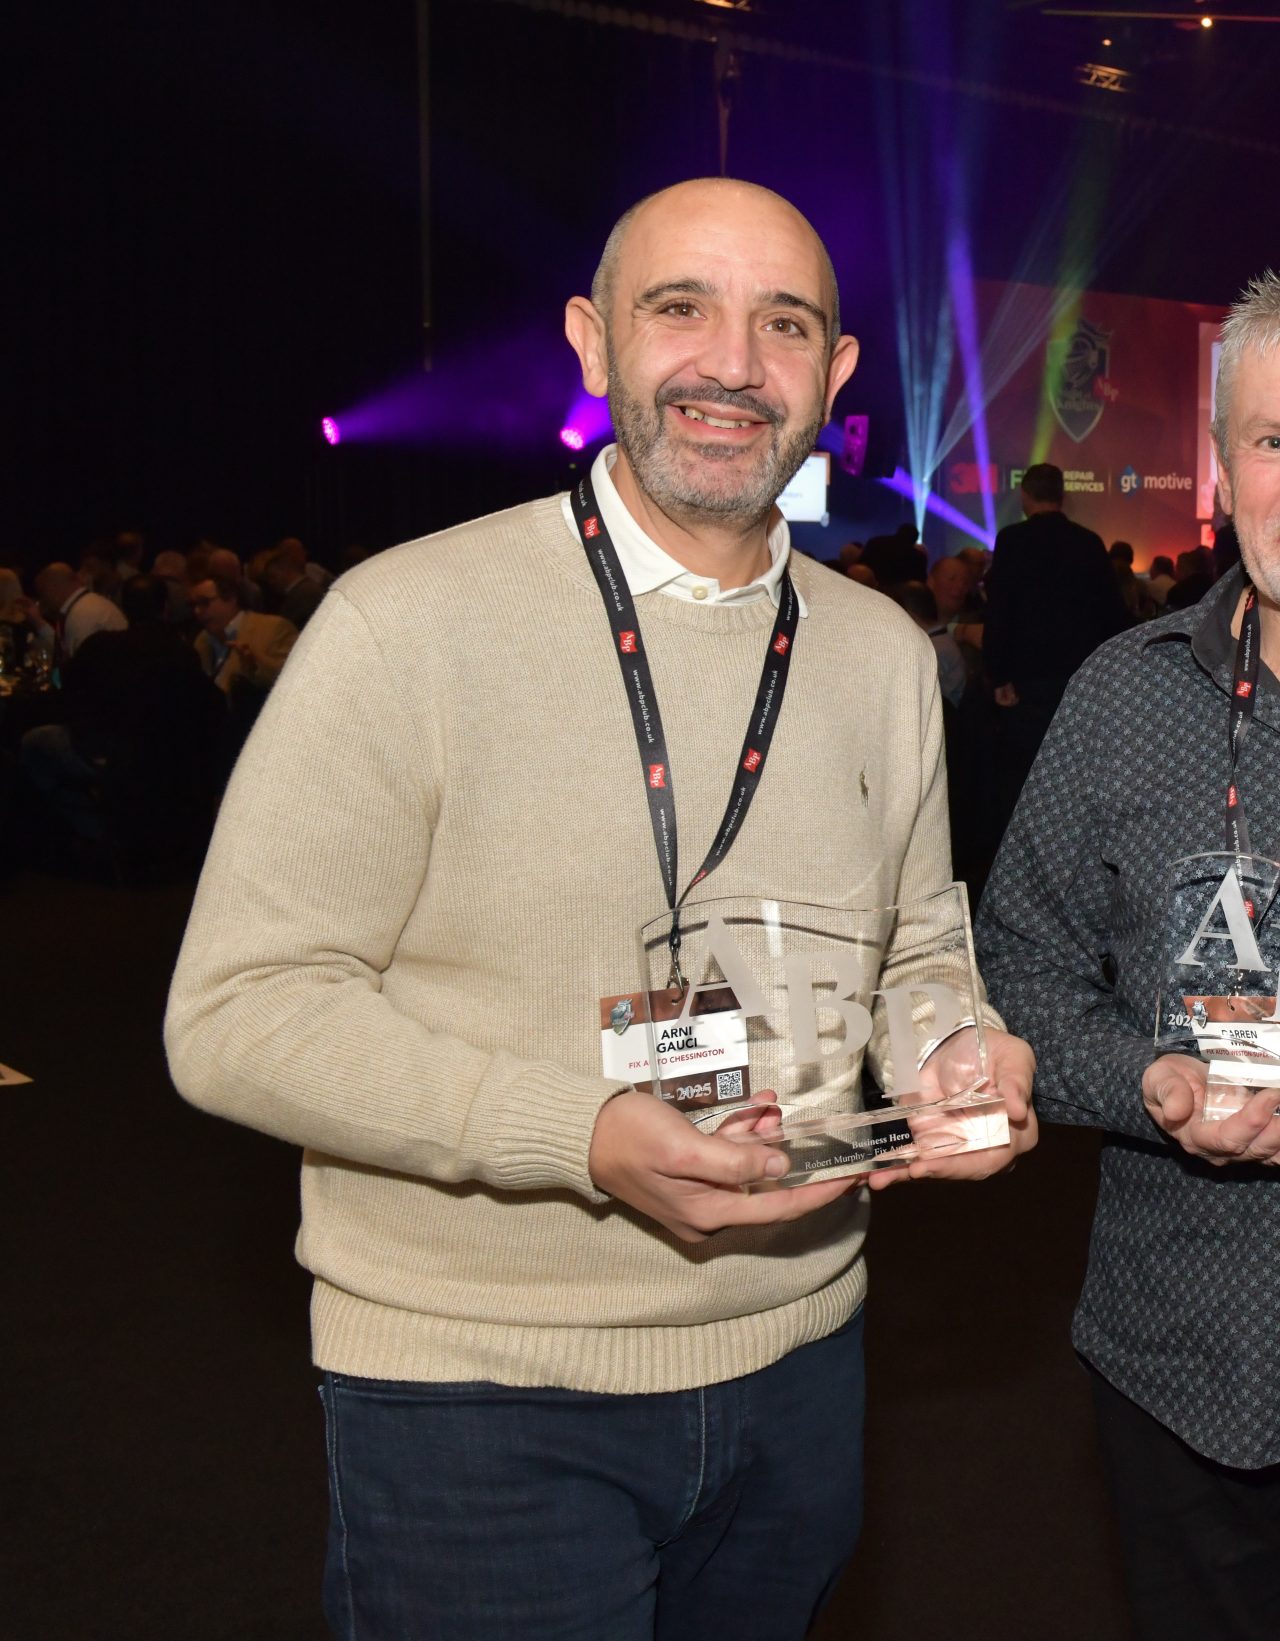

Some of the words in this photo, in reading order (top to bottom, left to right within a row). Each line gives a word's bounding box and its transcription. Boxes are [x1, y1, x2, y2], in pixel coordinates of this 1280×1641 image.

[1063, 471, 1094, 481] REPAIR
[1121, 473, 1137, 493] gt
[1144, 474, 1193, 490] motive
[1063, 482, 1104, 493] SERVICES
[598, 548, 624, 612] www.abpclub.co.uk
[633, 669, 654, 743] www.abpclub.co.uk
[757, 670, 779, 735] www.abpclub.co.uk
[716, 786, 746, 856] www.abpclub.co.uk
[674, 910, 961, 1098] ABP
[661, 1026, 692, 1040] ARNI
[656, 1037, 698, 1054] GAUCI
[629, 1061, 641, 1069] FIX
[643, 1057, 668, 1067] ATO
[669, 1048, 725, 1065] CHESSINGTON
[676, 1082, 712, 1101] 2025
[852, 1137, 887, 1150] Business
[890, 1132, 910, 1142] Hero
[805, 1158, 831, 1170] Robert
[834, 1152, 866, 1166] Murphy
